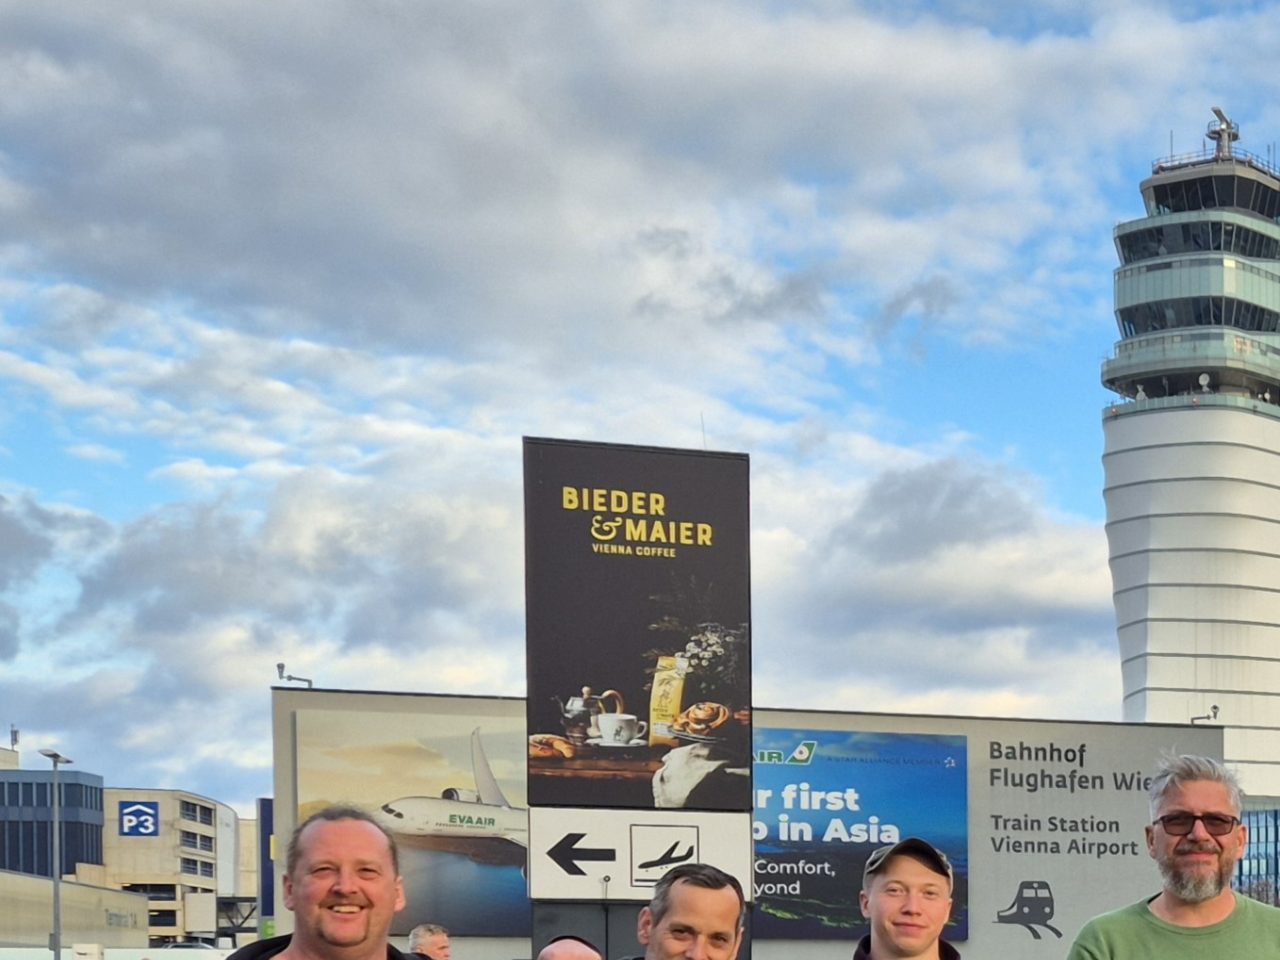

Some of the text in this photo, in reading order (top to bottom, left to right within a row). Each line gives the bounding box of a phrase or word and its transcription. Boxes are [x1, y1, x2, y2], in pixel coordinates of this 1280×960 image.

[562, 486, 666, 516] BIEDER
[592, 543, 677, 558] VIENNA COFFEE
[989, 741, 1087, 768] Bahnhof
[989, 768, 1152, 794] Flughafen Wie
[781, 782, 860, 812] first
[122, 815, 155, 834] P3
[778, 813, 813, 841] in
[822, 816, 900, 844] Asia
[990, 814, 1120, 833] Train Station
[990, 836, 1139, 858] Vienna Airport
[754, 860, 836, 877] Comfort,
